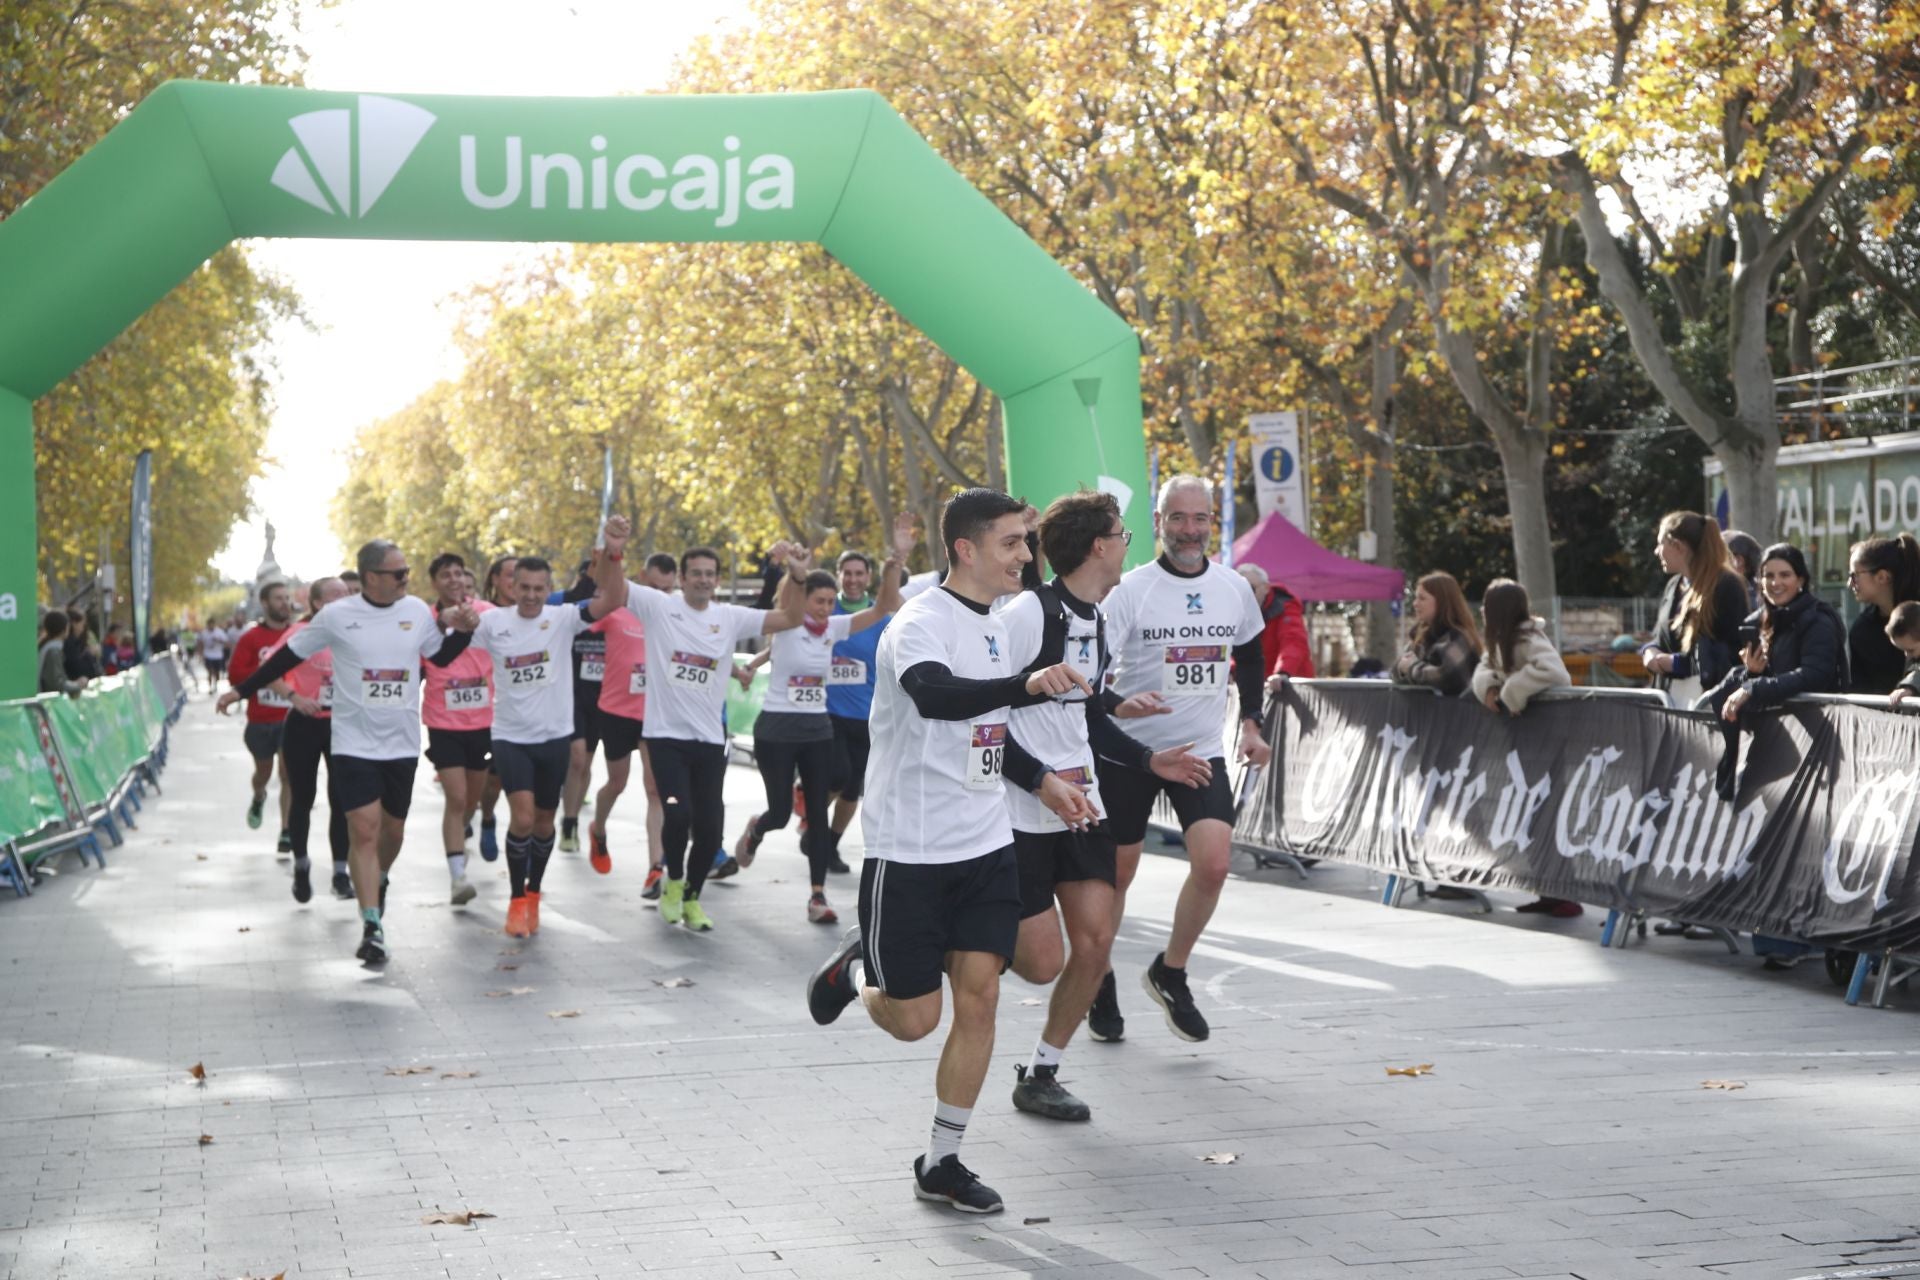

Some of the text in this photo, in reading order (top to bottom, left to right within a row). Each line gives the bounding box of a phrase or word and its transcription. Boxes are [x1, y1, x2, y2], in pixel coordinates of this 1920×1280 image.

[459, 134, 795, 228] Unicaja
[1143, 627, 1175, 641] RUN
[1179, 625, 1203, 638] ON
[511, 665, 546, 684] 252
[675, 665, 708, 685] 250
[831, 666, 860, 679] 586
[1175, 663, 1216, 686] 981
[369, 683, 403, 698] 254
[452, 688, 482, 704] 365
[794, 688, 822, 702] 255
[1489, 749, 1551, 852] de
